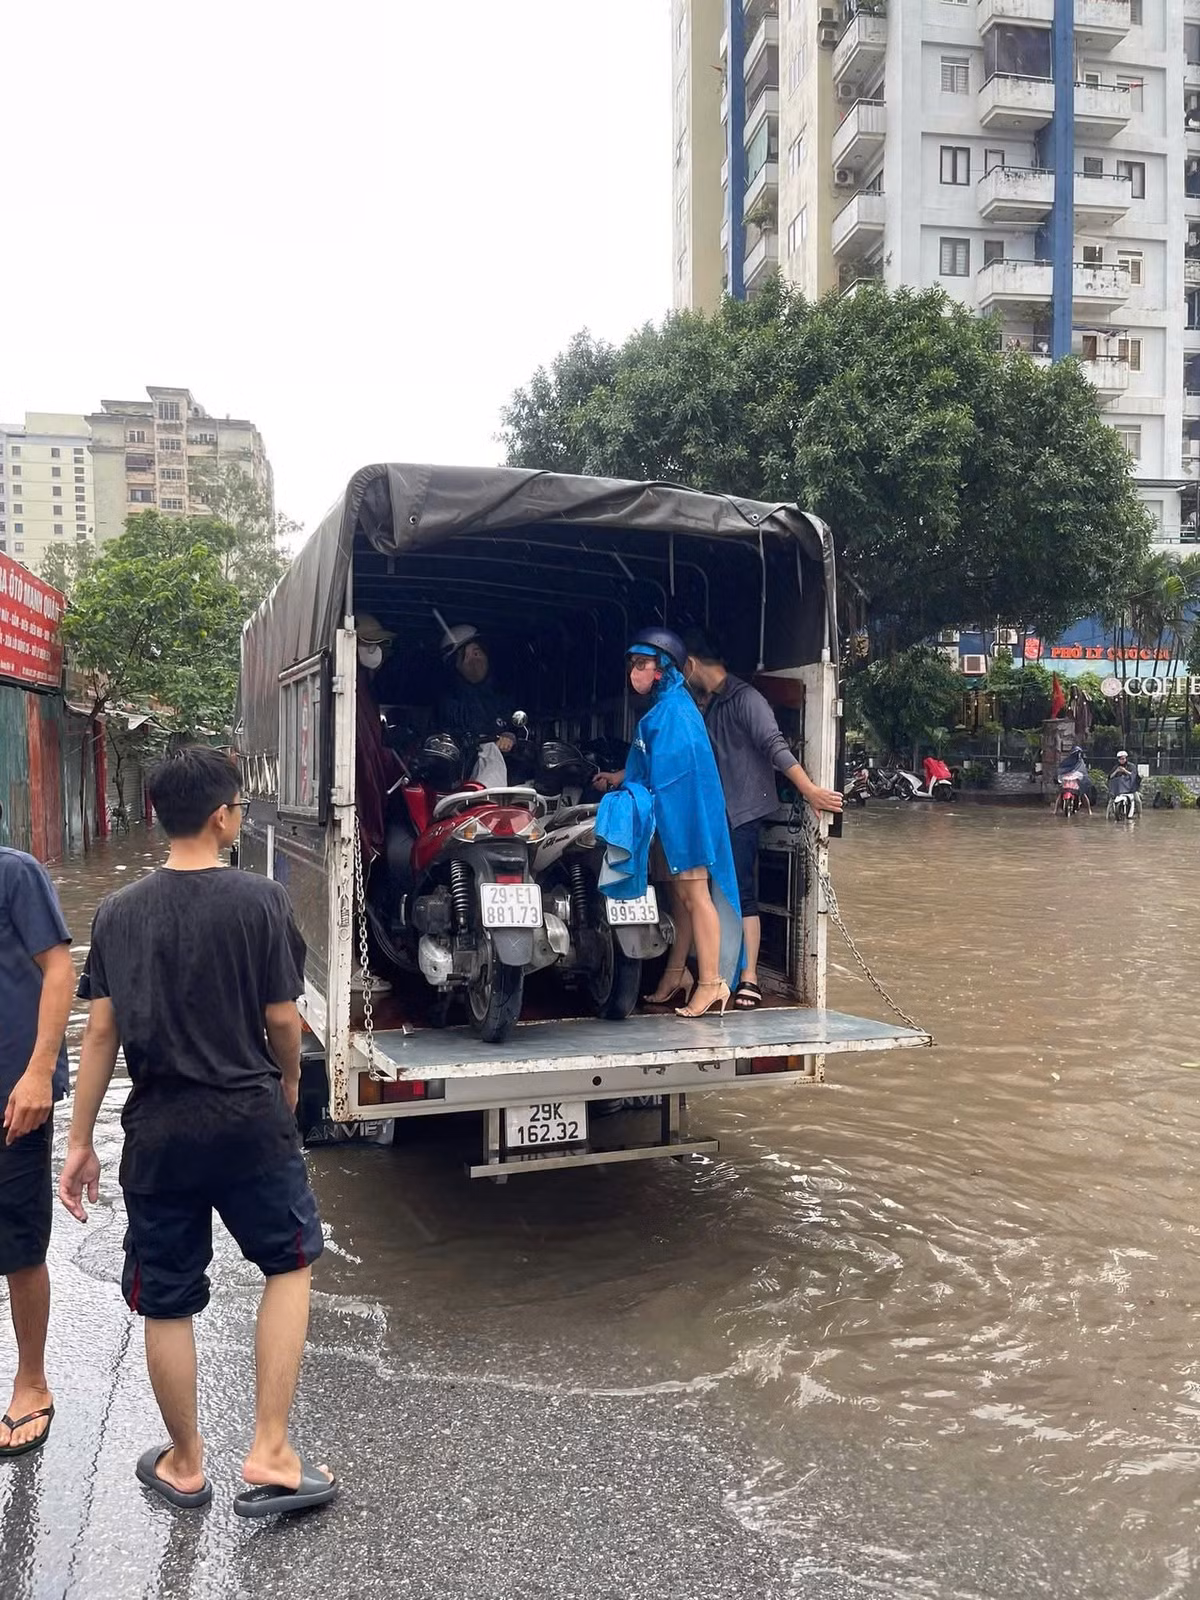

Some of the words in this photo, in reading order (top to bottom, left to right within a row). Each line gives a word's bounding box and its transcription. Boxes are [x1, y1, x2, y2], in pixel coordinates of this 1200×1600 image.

[1085, 644, 1104, 659] LÝ
[490, 887, 531, 904] 29-E1
[487, 906, 538, 924] 881.73
[610, 905, 656, 922] 995.35
[529, 1102, 563, 1122] 29K
[517, 1121, 578, 1144] 162.32
